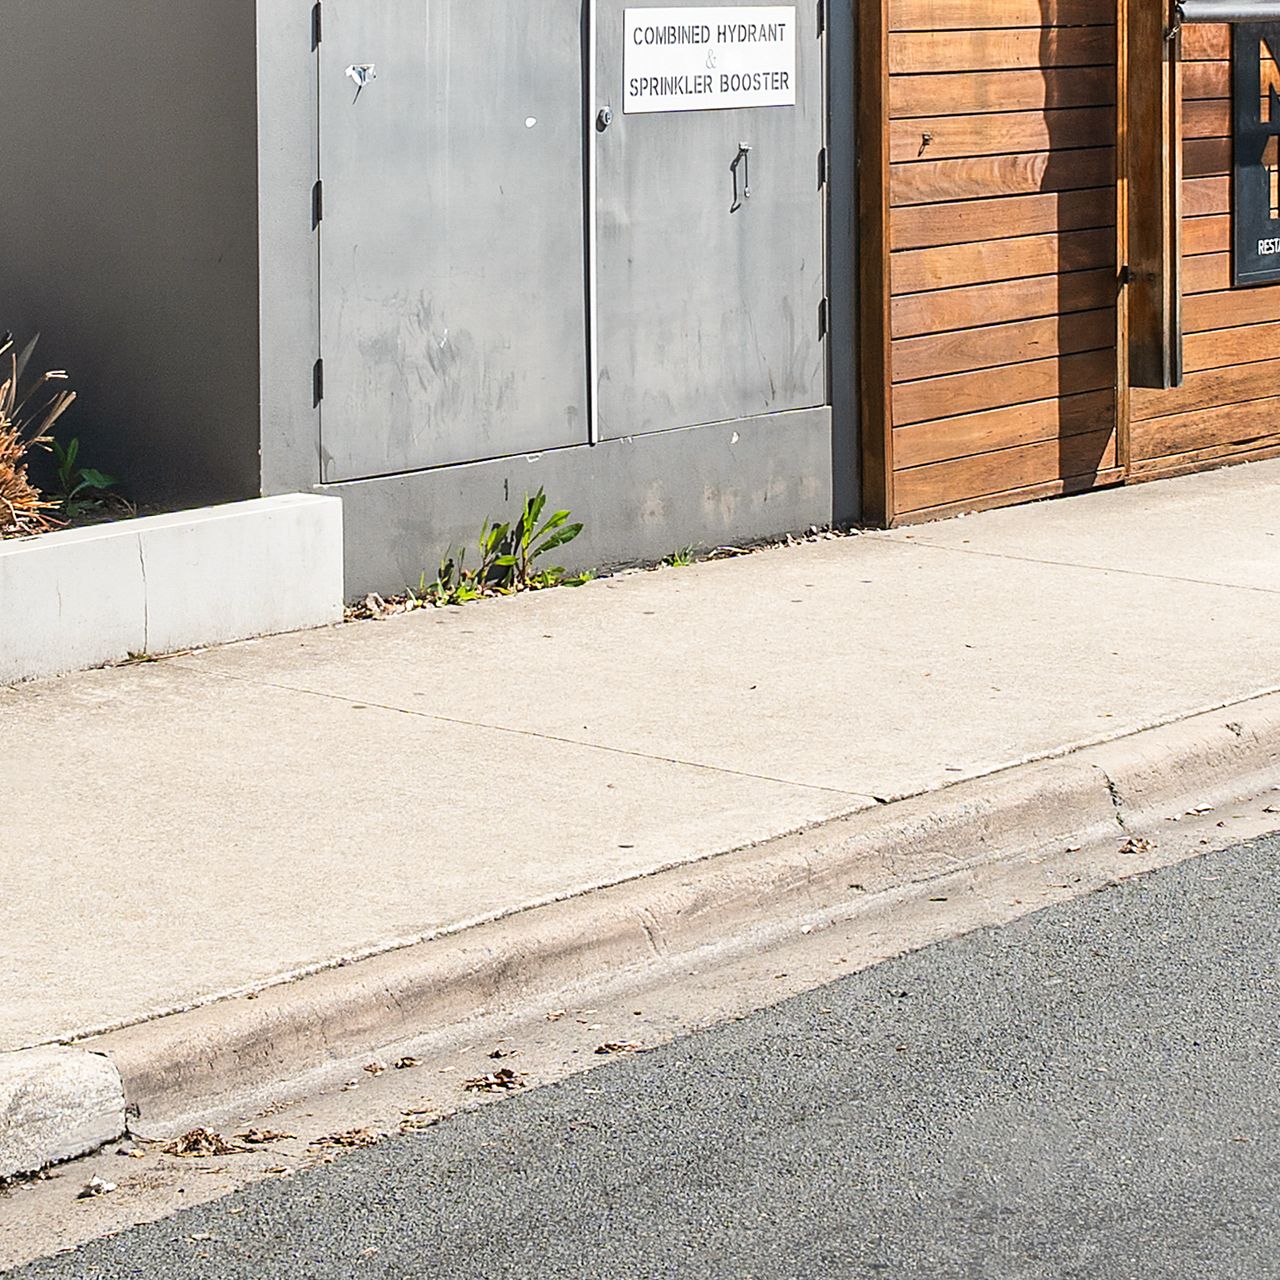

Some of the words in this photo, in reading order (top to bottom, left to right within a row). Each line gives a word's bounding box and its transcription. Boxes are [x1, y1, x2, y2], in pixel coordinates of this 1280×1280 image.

[633, 25, 710, 45] COMBINED
[717, 23, 786, 43] HYDRANT
[705, 48, 717, 70] &
[629, 75, 713, 97] SPRINKLER
[720, 72, 789, 93] BOOSTER
